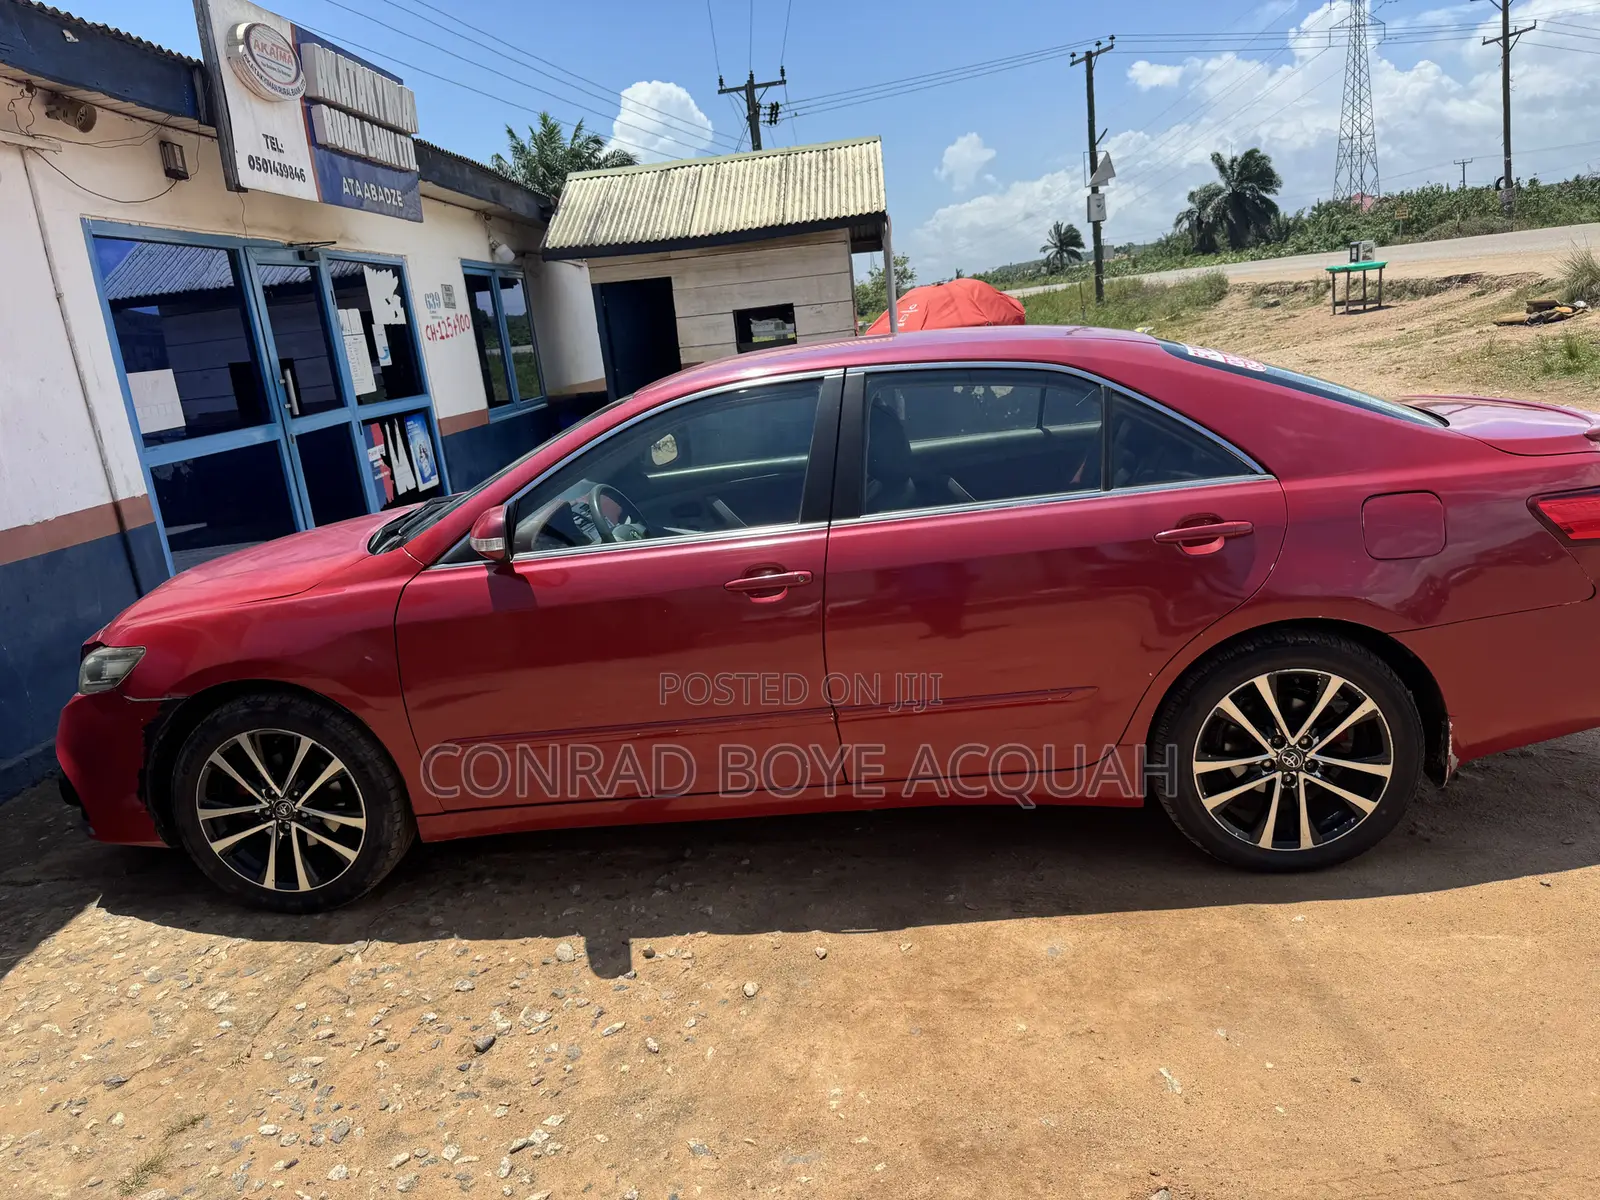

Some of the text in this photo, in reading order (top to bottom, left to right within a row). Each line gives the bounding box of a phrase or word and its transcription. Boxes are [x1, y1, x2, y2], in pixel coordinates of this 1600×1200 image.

[321, 103, 366, 156] RURAL
[363, 120, 400, 167] BANK
[247, 154, 306, 183] 0501439846
